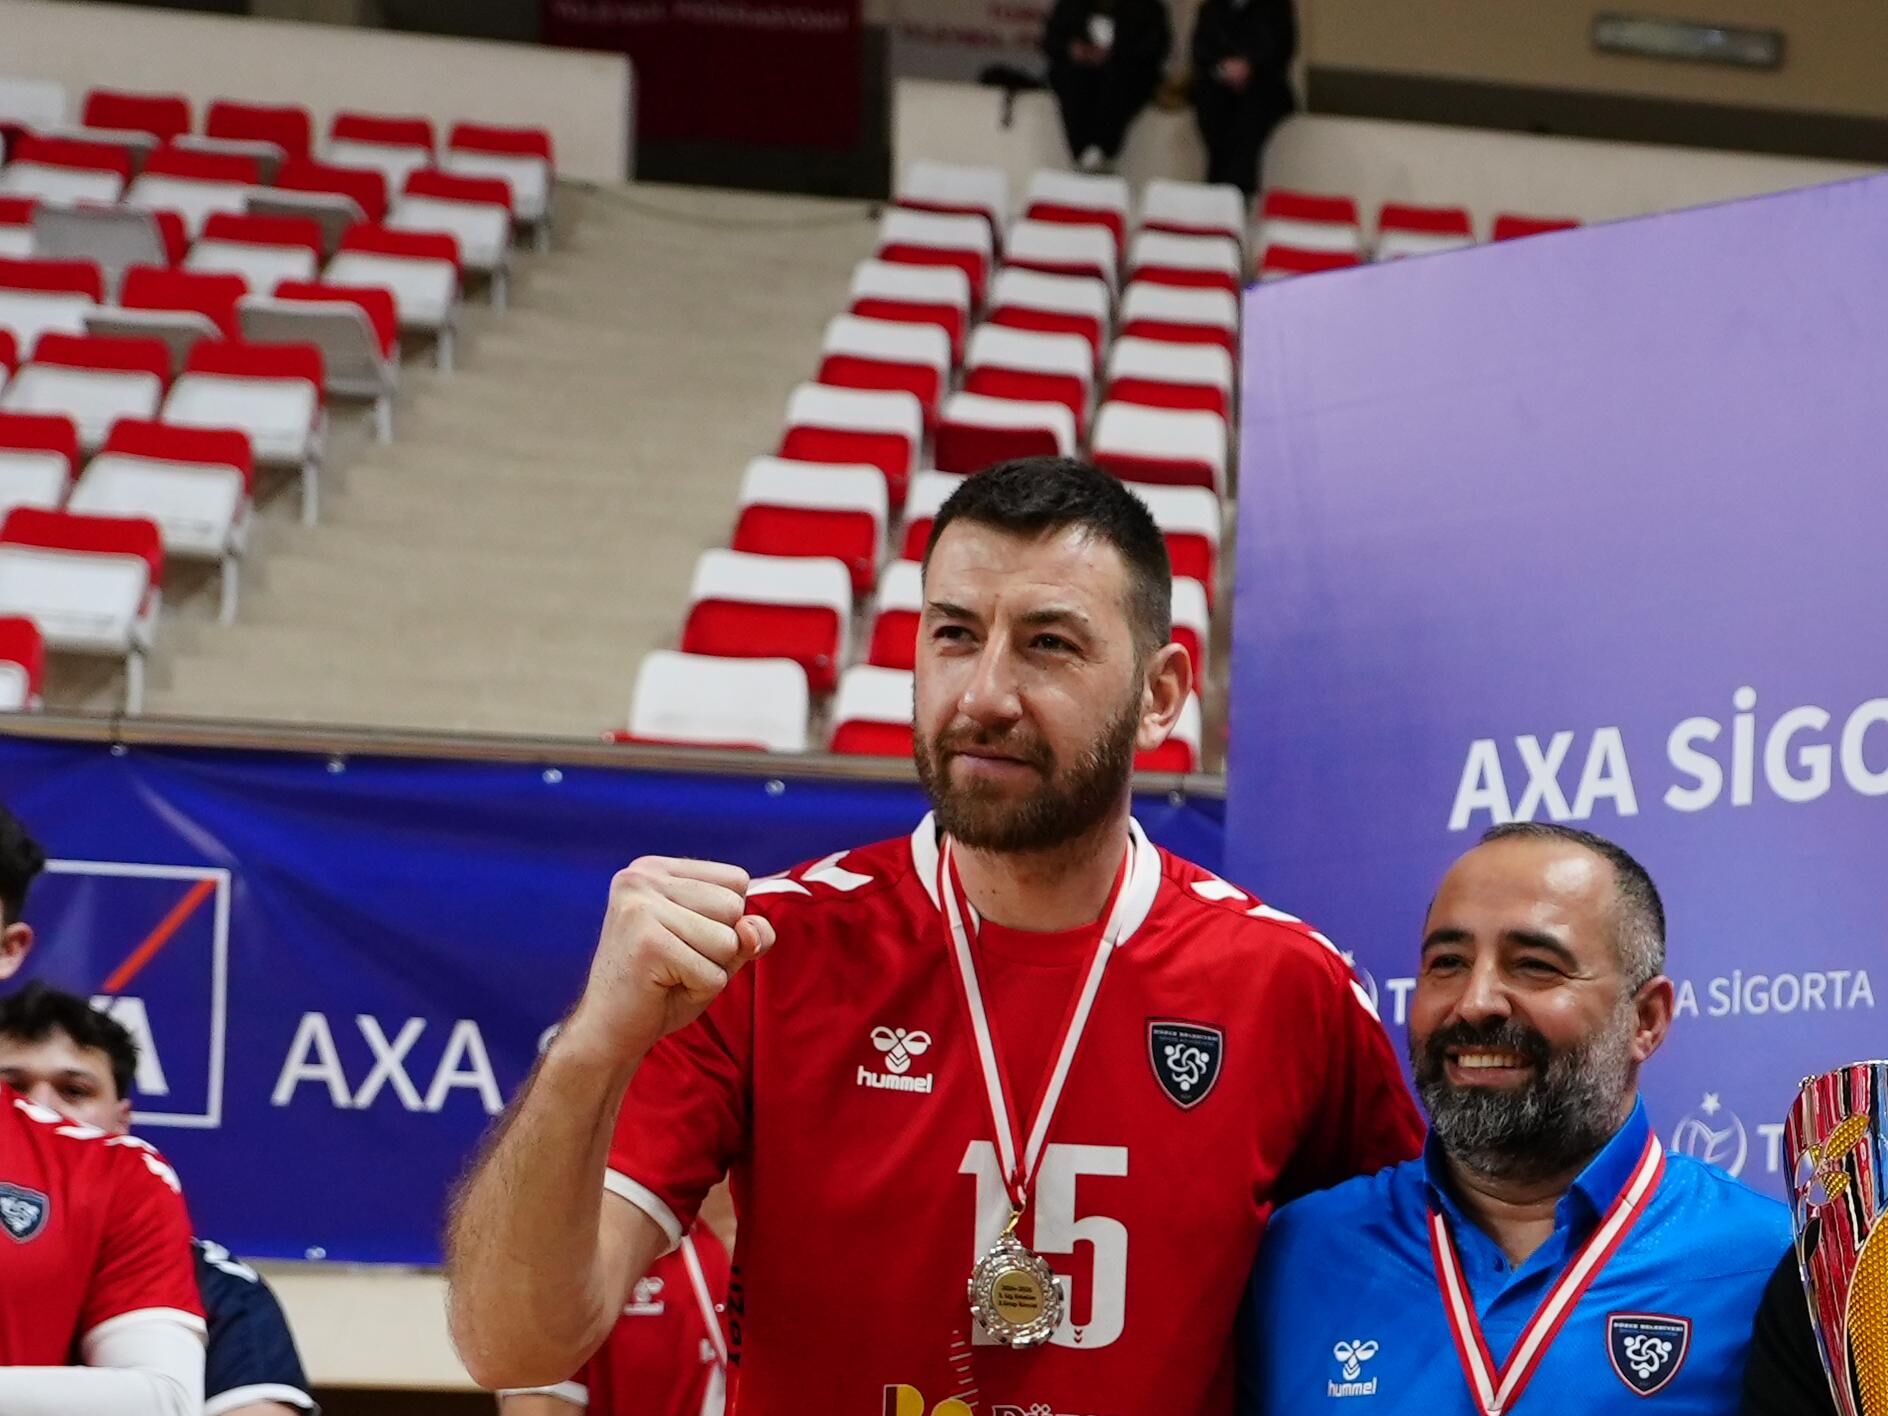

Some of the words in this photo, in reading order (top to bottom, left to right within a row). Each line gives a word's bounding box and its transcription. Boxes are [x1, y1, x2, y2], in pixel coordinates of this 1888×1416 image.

[1447, 727, 1640, 832] AXA
[1707, 968, 1876, 1018] SİGORTA
[270, 1010, 505, 1116] AXA
[857, 1065, 933, 1093] hummel
[957, 1139, 1128, 1350] 15
[1327, 1376, 1377, 1397] hummel
